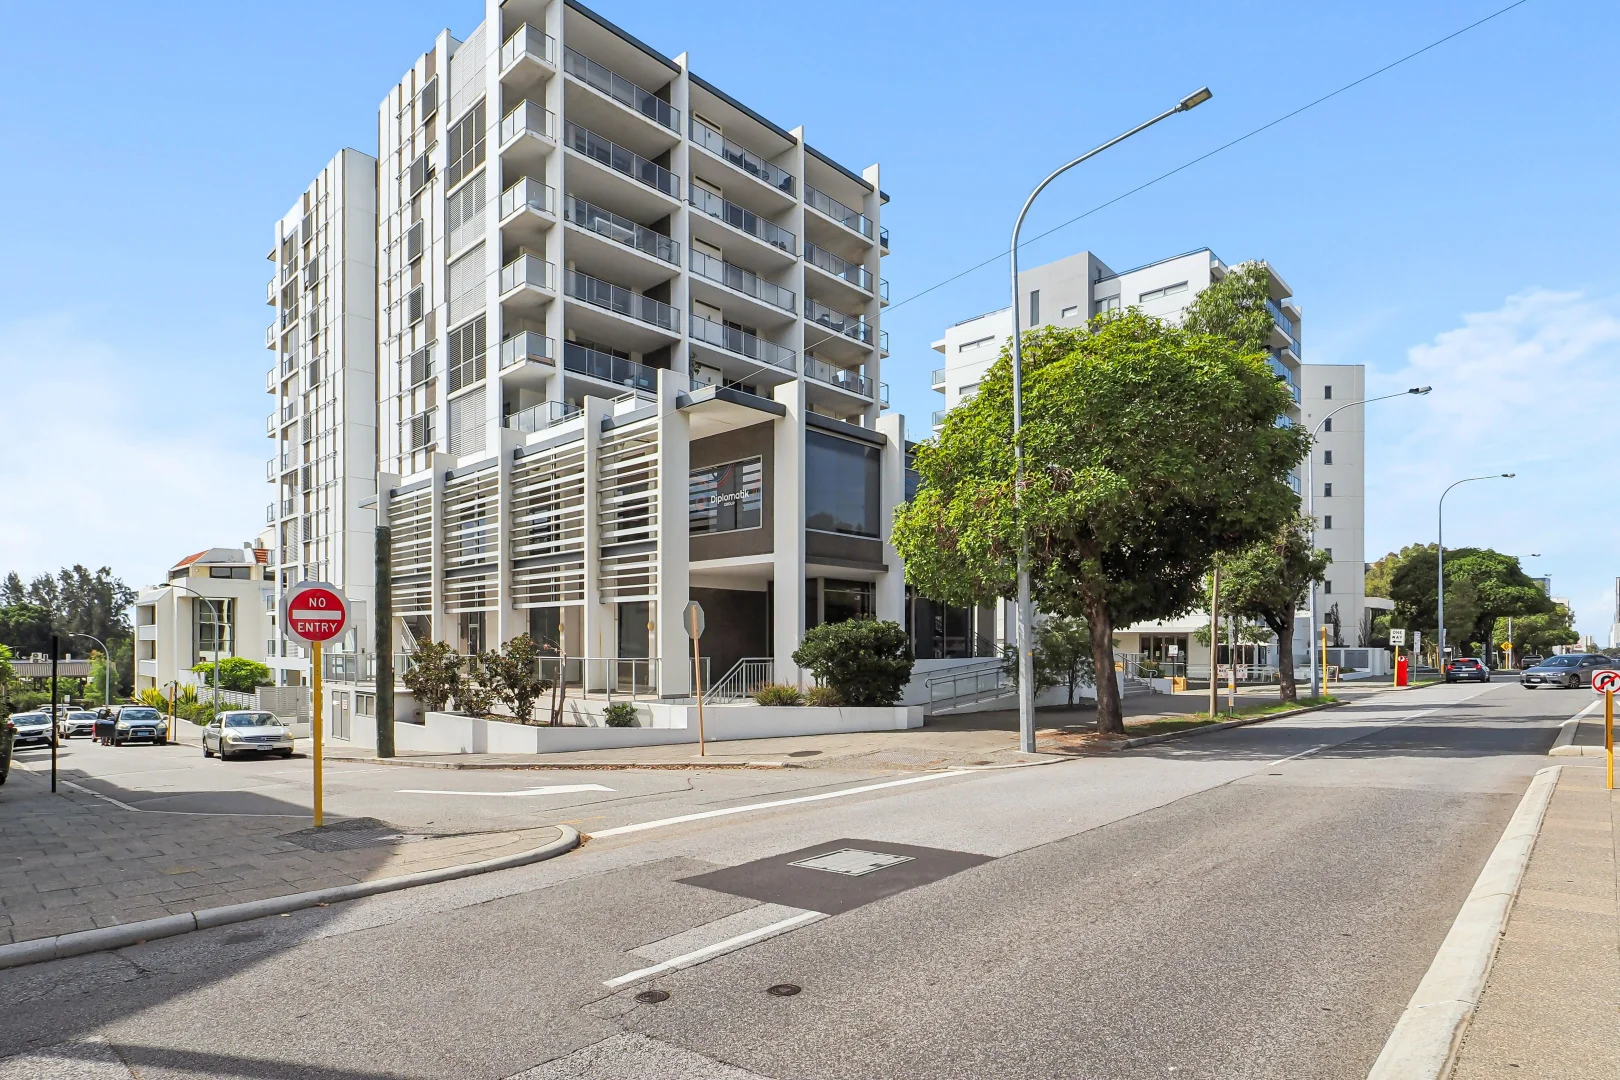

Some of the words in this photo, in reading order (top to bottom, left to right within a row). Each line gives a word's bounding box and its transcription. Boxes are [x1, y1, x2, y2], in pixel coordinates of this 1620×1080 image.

[710, 489, 750, 504] Diplomatik
[309, 597, 326, 608] NO
[298, 622, 338, 633] ENTRY
